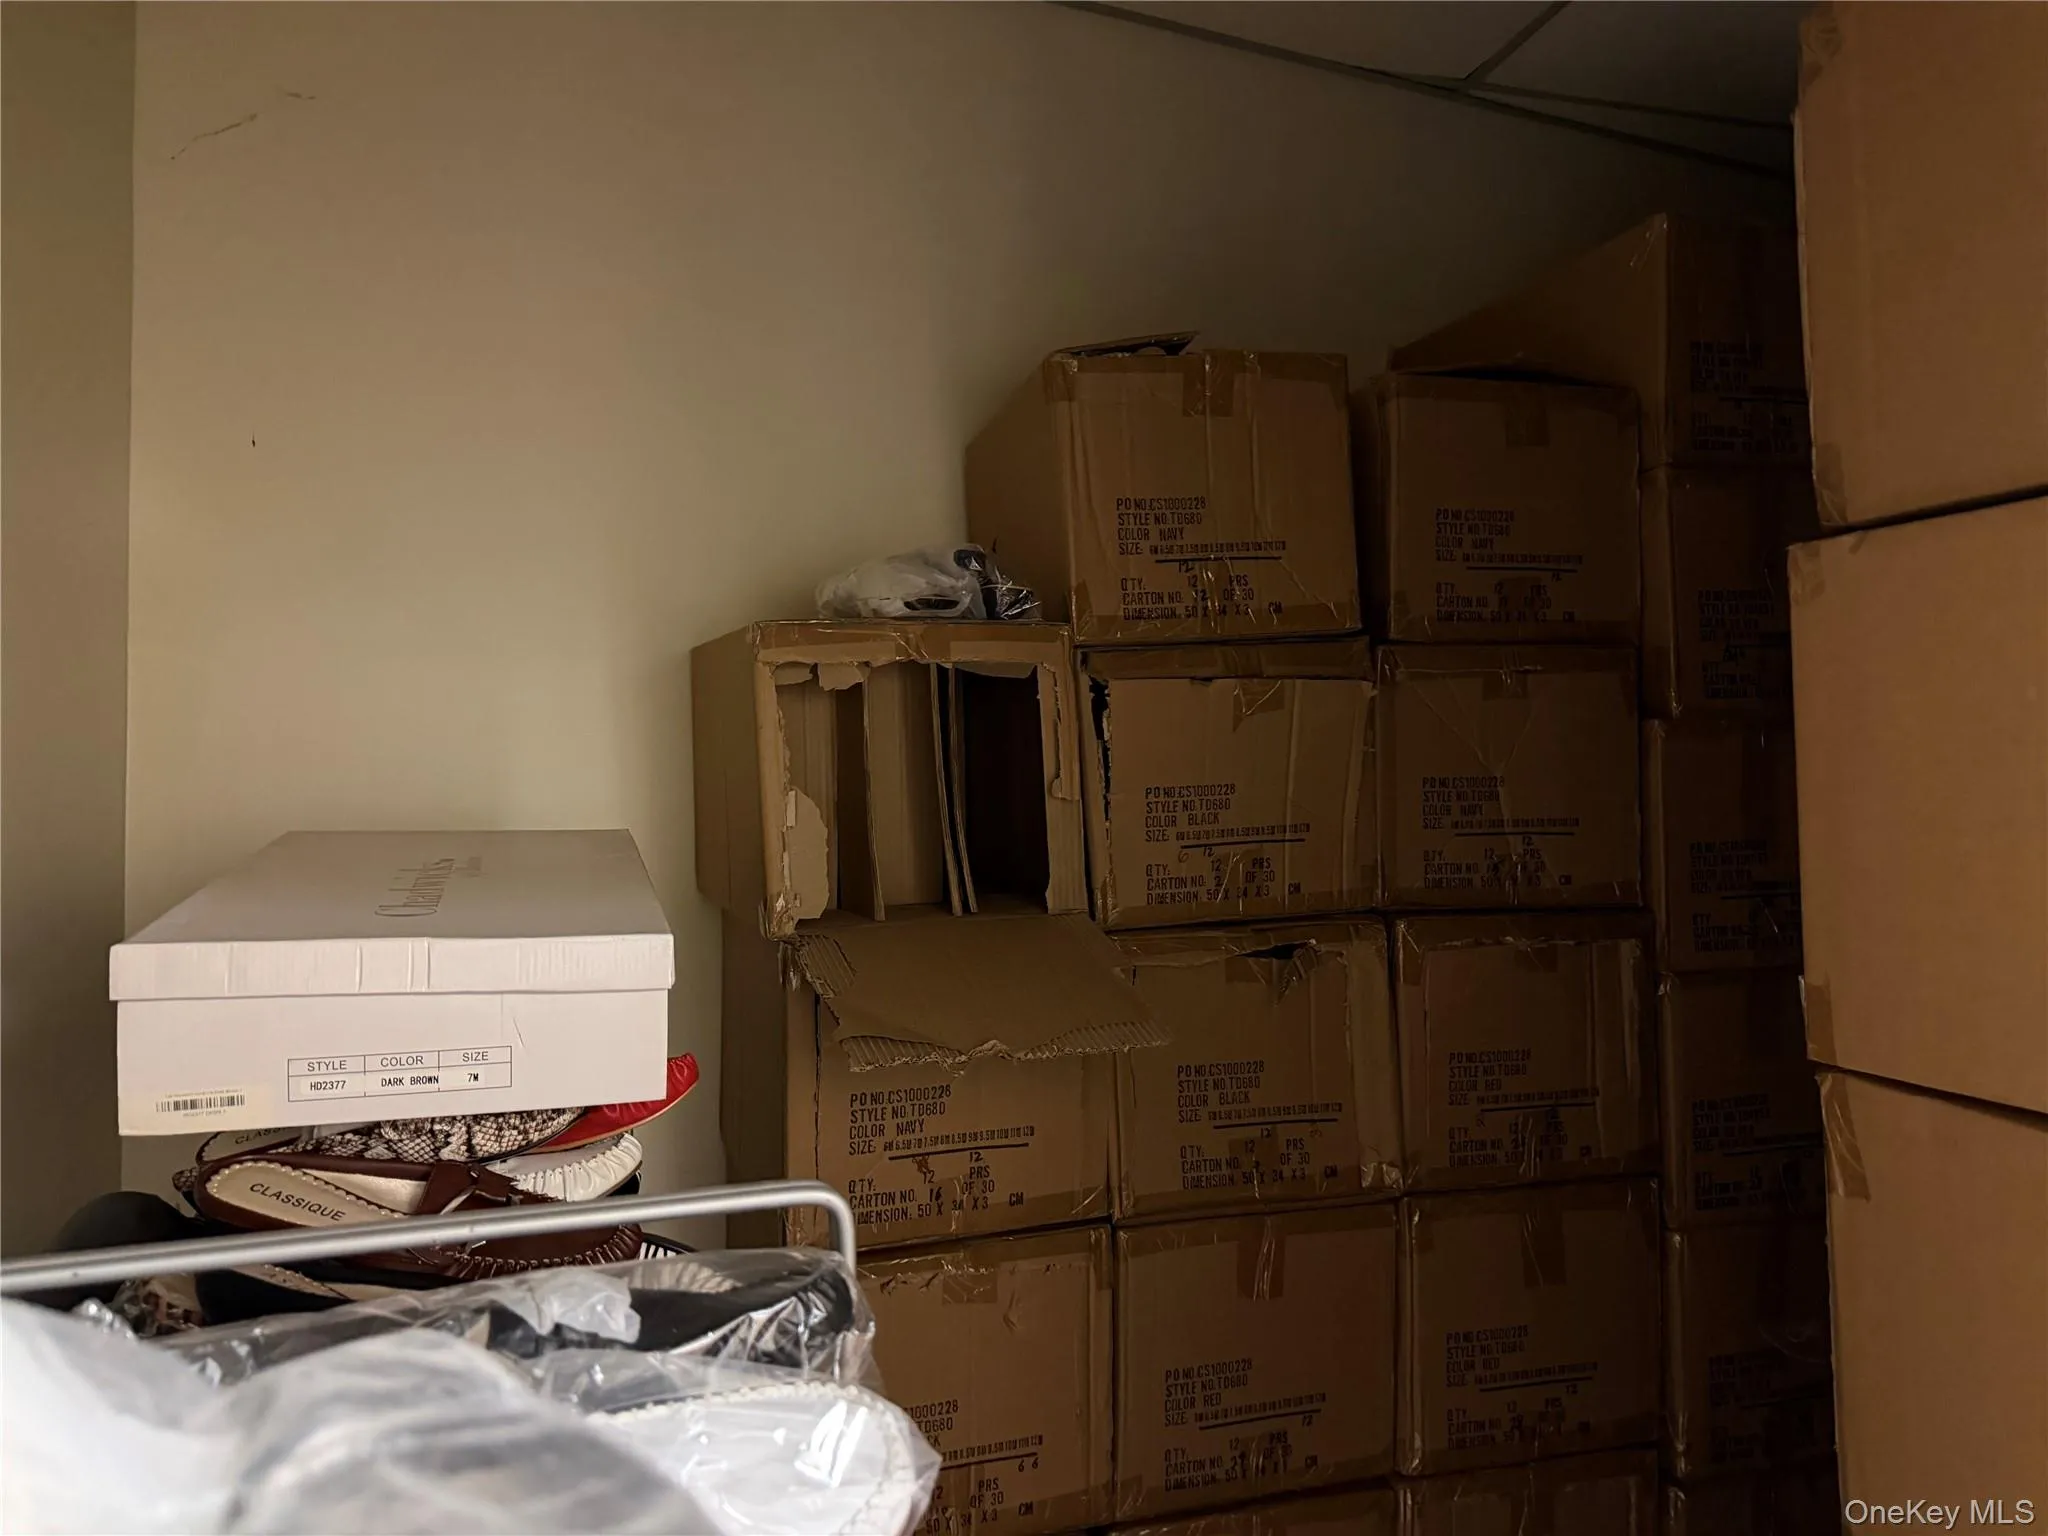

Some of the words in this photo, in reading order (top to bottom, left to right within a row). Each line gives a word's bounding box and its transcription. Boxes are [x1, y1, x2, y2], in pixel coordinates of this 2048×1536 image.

[1118, 513, 1150, 526] STYLE
[1118, 528, 1150, 541] COLOR
[1159, 528, 1184, 541] NAVY
[1436, 523, 1464, 535] STYLE
[1436, 537, 1463, 549] COLOR
[1472, 538, 1494, 550] NAVY
[1187, 576, 1198, 588] 12
[1229, 575, 1248, 587] PRS
[1122, 592, 1164, 606] CARTON
[1242, 588, 1253, 600] 30
[1423, 791, 1452, 802] STYLE
[1146, 801, 1178, 814] STYLE
[1423, 804, 1452, 816] COLOR
[1460, 804, 1483, 816] NAVY
[1145, 815, 1177, 828] COLOR
[1188, 812, 1220, 826] BLACK
[1484, 848, 1495, 859] 12
[1523, 849, 1542, 860] PRS
[1211, 859, 1221, 872] 12
[1252, 857, 1271, 870] PRS
[1424, 863, 1462, 875] CARTON
[1147, 877, 1186, 891] CARTON
[1263, 871, 1275, 883] 30
[1206, 889, 1218, 900] 50
[1255, 886, 1261, 897] X
[1264, 885, 1270, 897] 3
[1288, 882, 1301, 895] CM
[307, 1060, 347, 1072] STYLE
[380, 1055, 424, 1067] COLOR
[462, 1051, 489, 1062] SIZE
[1449, 1066, 1479, 1078] STYLE
[310, 1080, 346, 1091] HD2377
[381, 1077, 405, 1087] DARK
[410, 1075, 439, 1085] BROWN
[467, 1073, 479, 1082] 7M
[1178, 1079, 1209, 1094] STYLE
[1449, 1080, 1477, 1092] COLOR
[850, 1092, 867, 1108] PO
[1178, 1094, 1208, 1108] COLOR
[1219, 1091, 1250, 1106] BLACK
[850, 1107, 887, 1124] STYLE
[850, 1123, 885, 1140] COLOR
[896, 1118, 924, 1136] NAVY
[849, 1139, 876, 1156] SIZE:
[1286, 1137, 1304, 1150] PRS
[1450, 1140, 1487, 1153] CARTON
[1182, 1158, 1222, 1174] CARTON
[1280, 1153, 1292, 1165] OF
[1298, 1152, 1310, 1164] 30
[923, 1170, 935, 1184] 12
[969, 1165, 990, 1180] PRS
[250, 1183, 346, 1221] CLASSIQUE
[849, 1192, 897, 1210] CARTON
[962, 1181, 974, 1195] OF
[981, 1180, 995, 1193] 30
[918, 1204, 931, 1217] 50
[936, 1202, 943, 1216] X
[972, 1197, 978, 1211] X
[982, 1196, 988, 1209] 3
[1009, 1192, 1024, 1207] CM
[1447, 1345, 1476, 1360] STYLE
[1447, 1361, 1475, 1373] COLOR
[1165, 1383, 1197, 1398] STYLE
[1165, 1397, 1196, 1413] COLOR
[1203, 1393, 1221, 1408] RED
[1229, 1437, 1239, 1451] 12
[1018, 1459, 1024, 1472] 6
[1032, 1457, 1038, 1469] 6
[1166, 1459, 1205, 1477] CARTON
[979, 1478, 999, 1493] PRS
[970, 1495, 984, 1508] OF
[991, 1492, 1004, 1505] 30
[1019, 1502, 1033, 1517] CM
